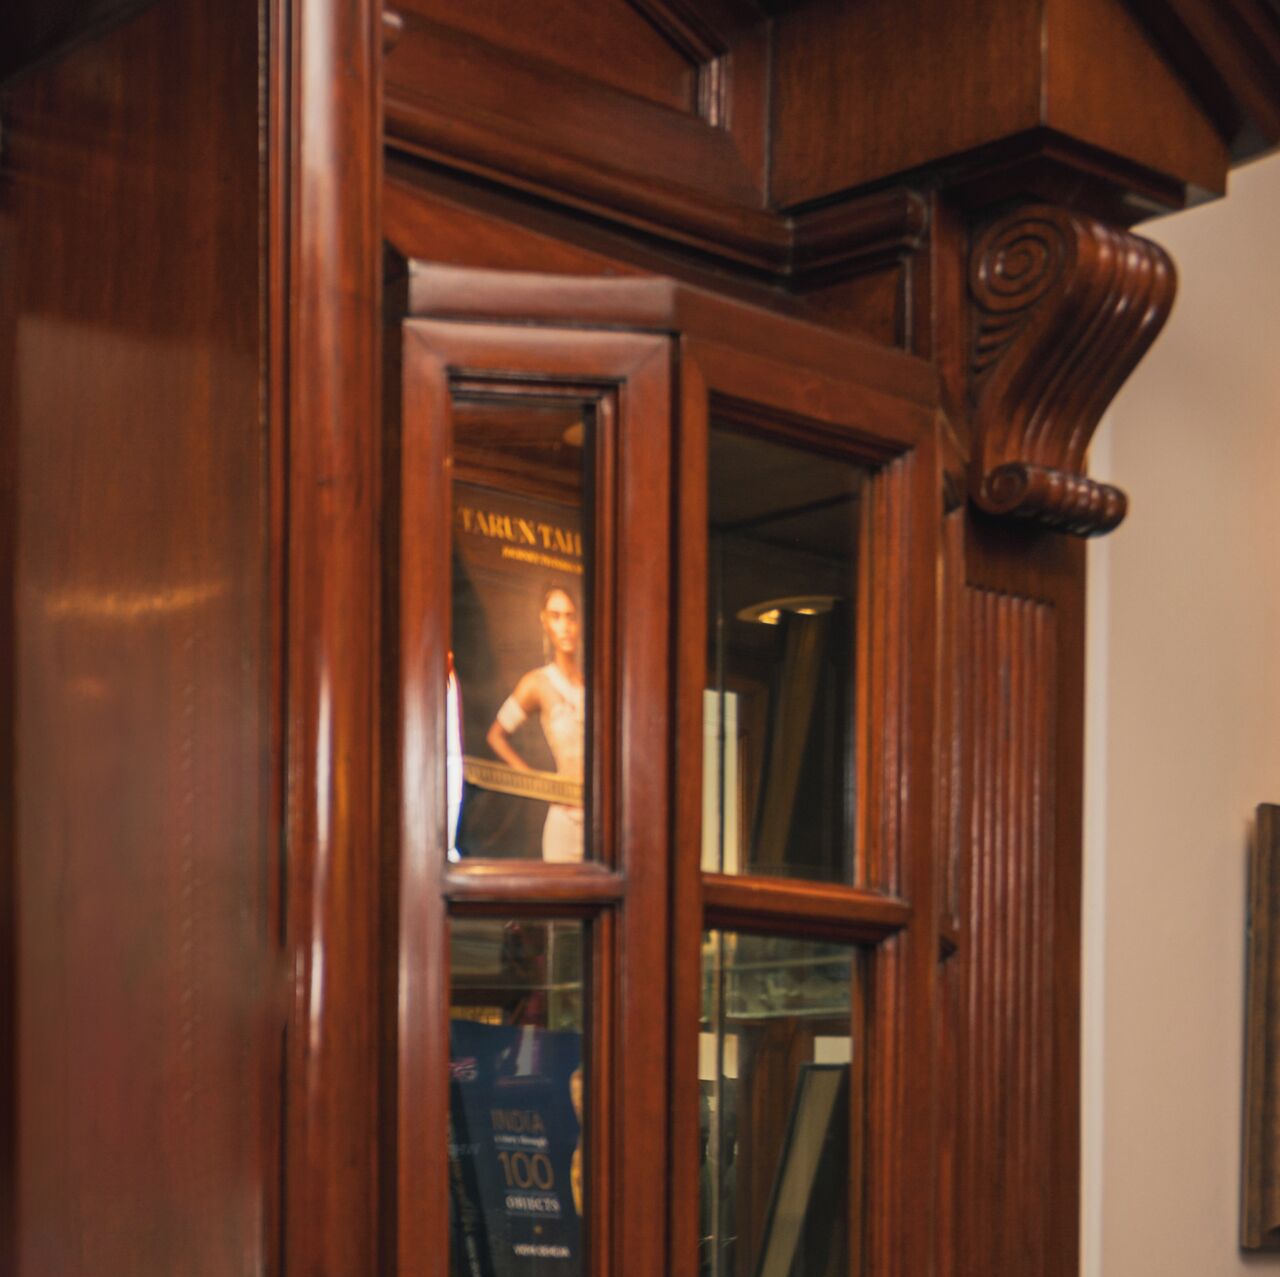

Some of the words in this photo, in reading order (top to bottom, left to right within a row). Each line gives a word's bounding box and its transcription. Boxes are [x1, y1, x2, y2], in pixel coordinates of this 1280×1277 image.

[458, 505, 536, 545] TARUN
[490, 1108, 545, 1133] INDIA
[497, 1151, 555, 1190] 100
[504, 1194, 561, 1212] OBJECTS
